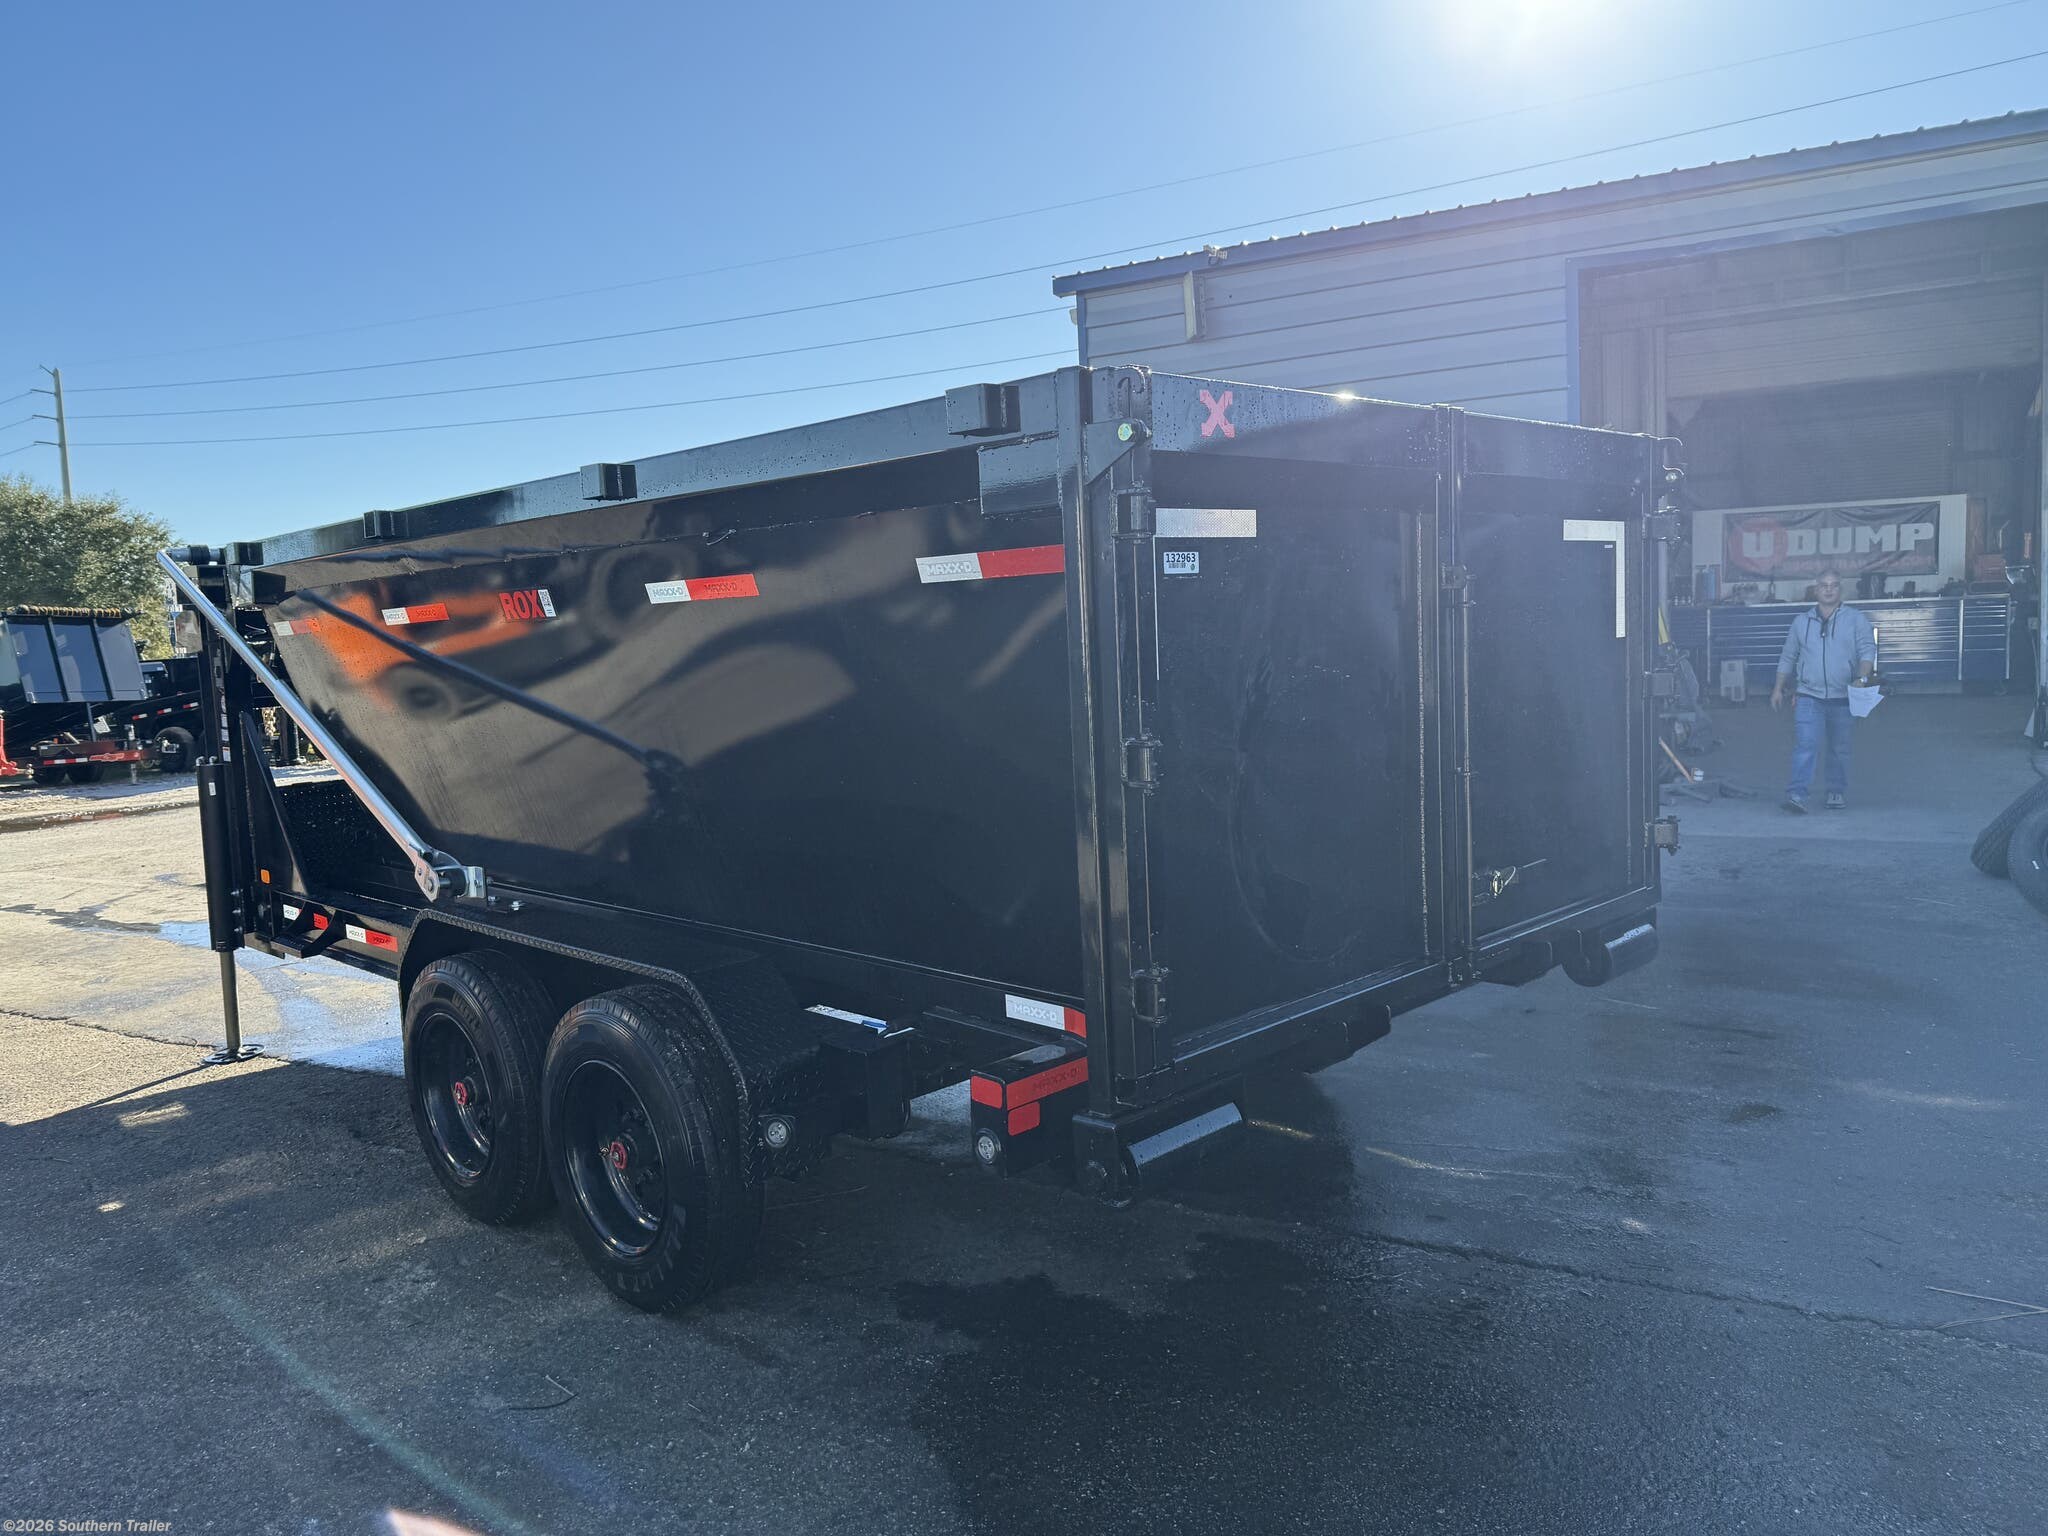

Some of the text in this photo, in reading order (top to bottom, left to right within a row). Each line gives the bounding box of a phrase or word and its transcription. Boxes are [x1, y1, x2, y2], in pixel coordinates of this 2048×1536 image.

[1786, 522, 1935, 556] DUMP
[1165, 552, 1196, 563] 132963
[499, 589, 545, 621] ROX
